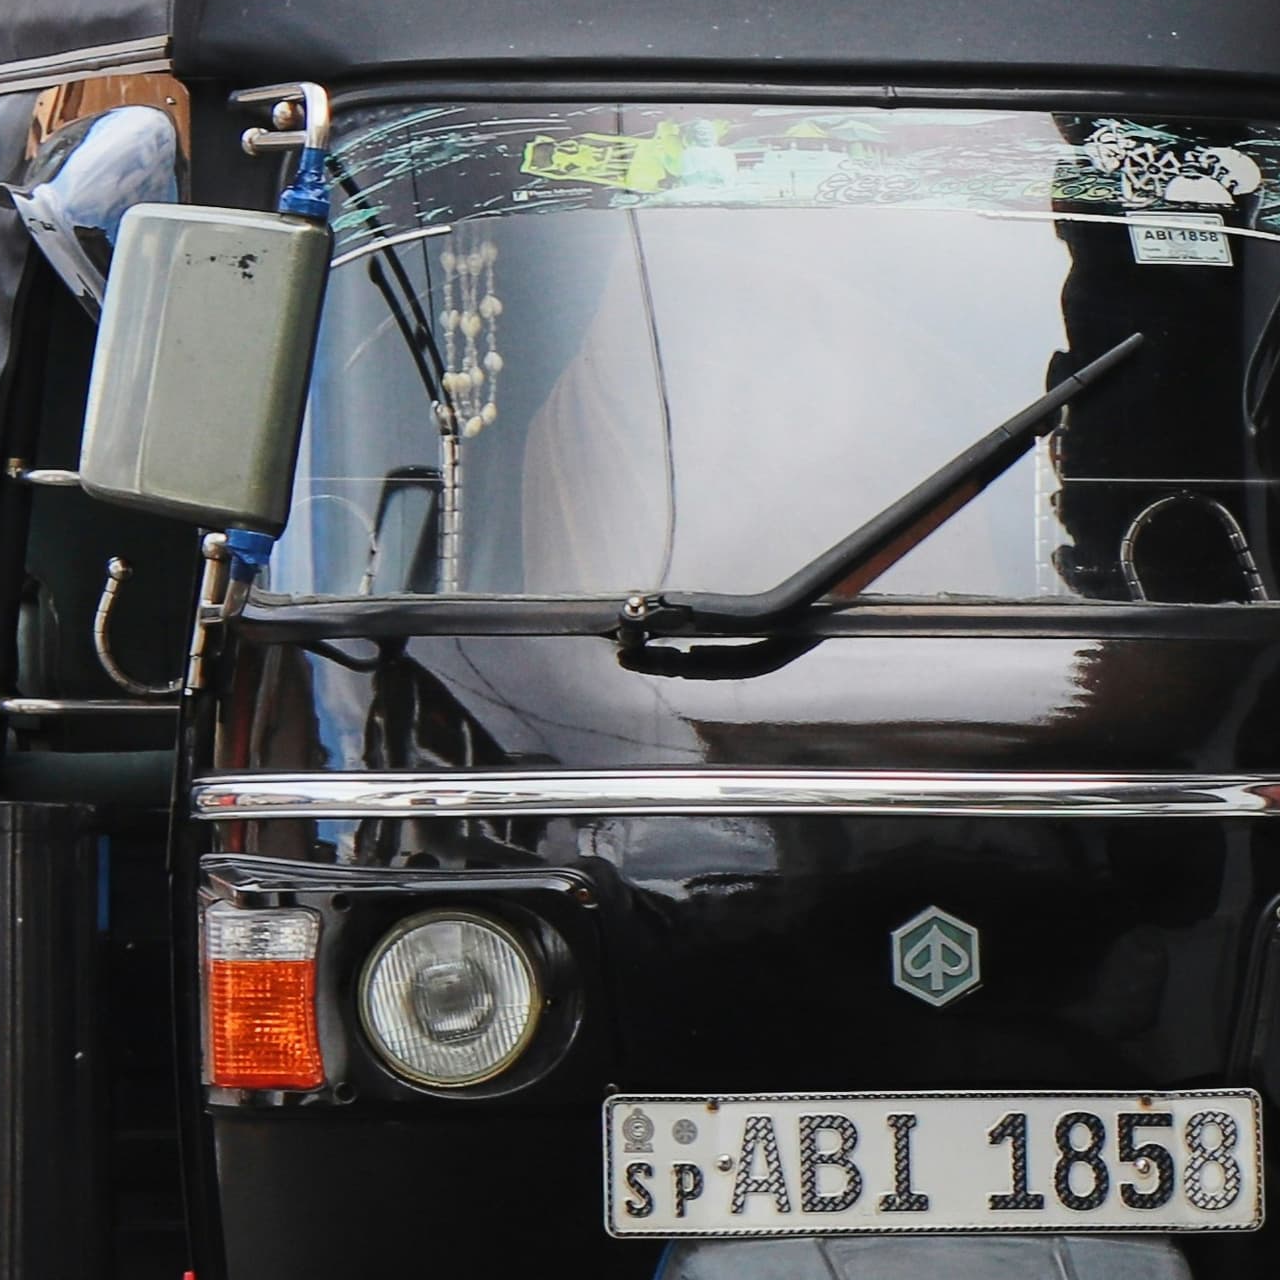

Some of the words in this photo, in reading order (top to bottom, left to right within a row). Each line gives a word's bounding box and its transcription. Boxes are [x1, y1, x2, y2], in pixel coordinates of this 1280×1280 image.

[1144, 229, 1174, 241] ABI
[1178, 230, 1220, 242] 1858
[731, 1114, 930, 1214] ABI
[985, 1110, 1242, 1211] 1858
